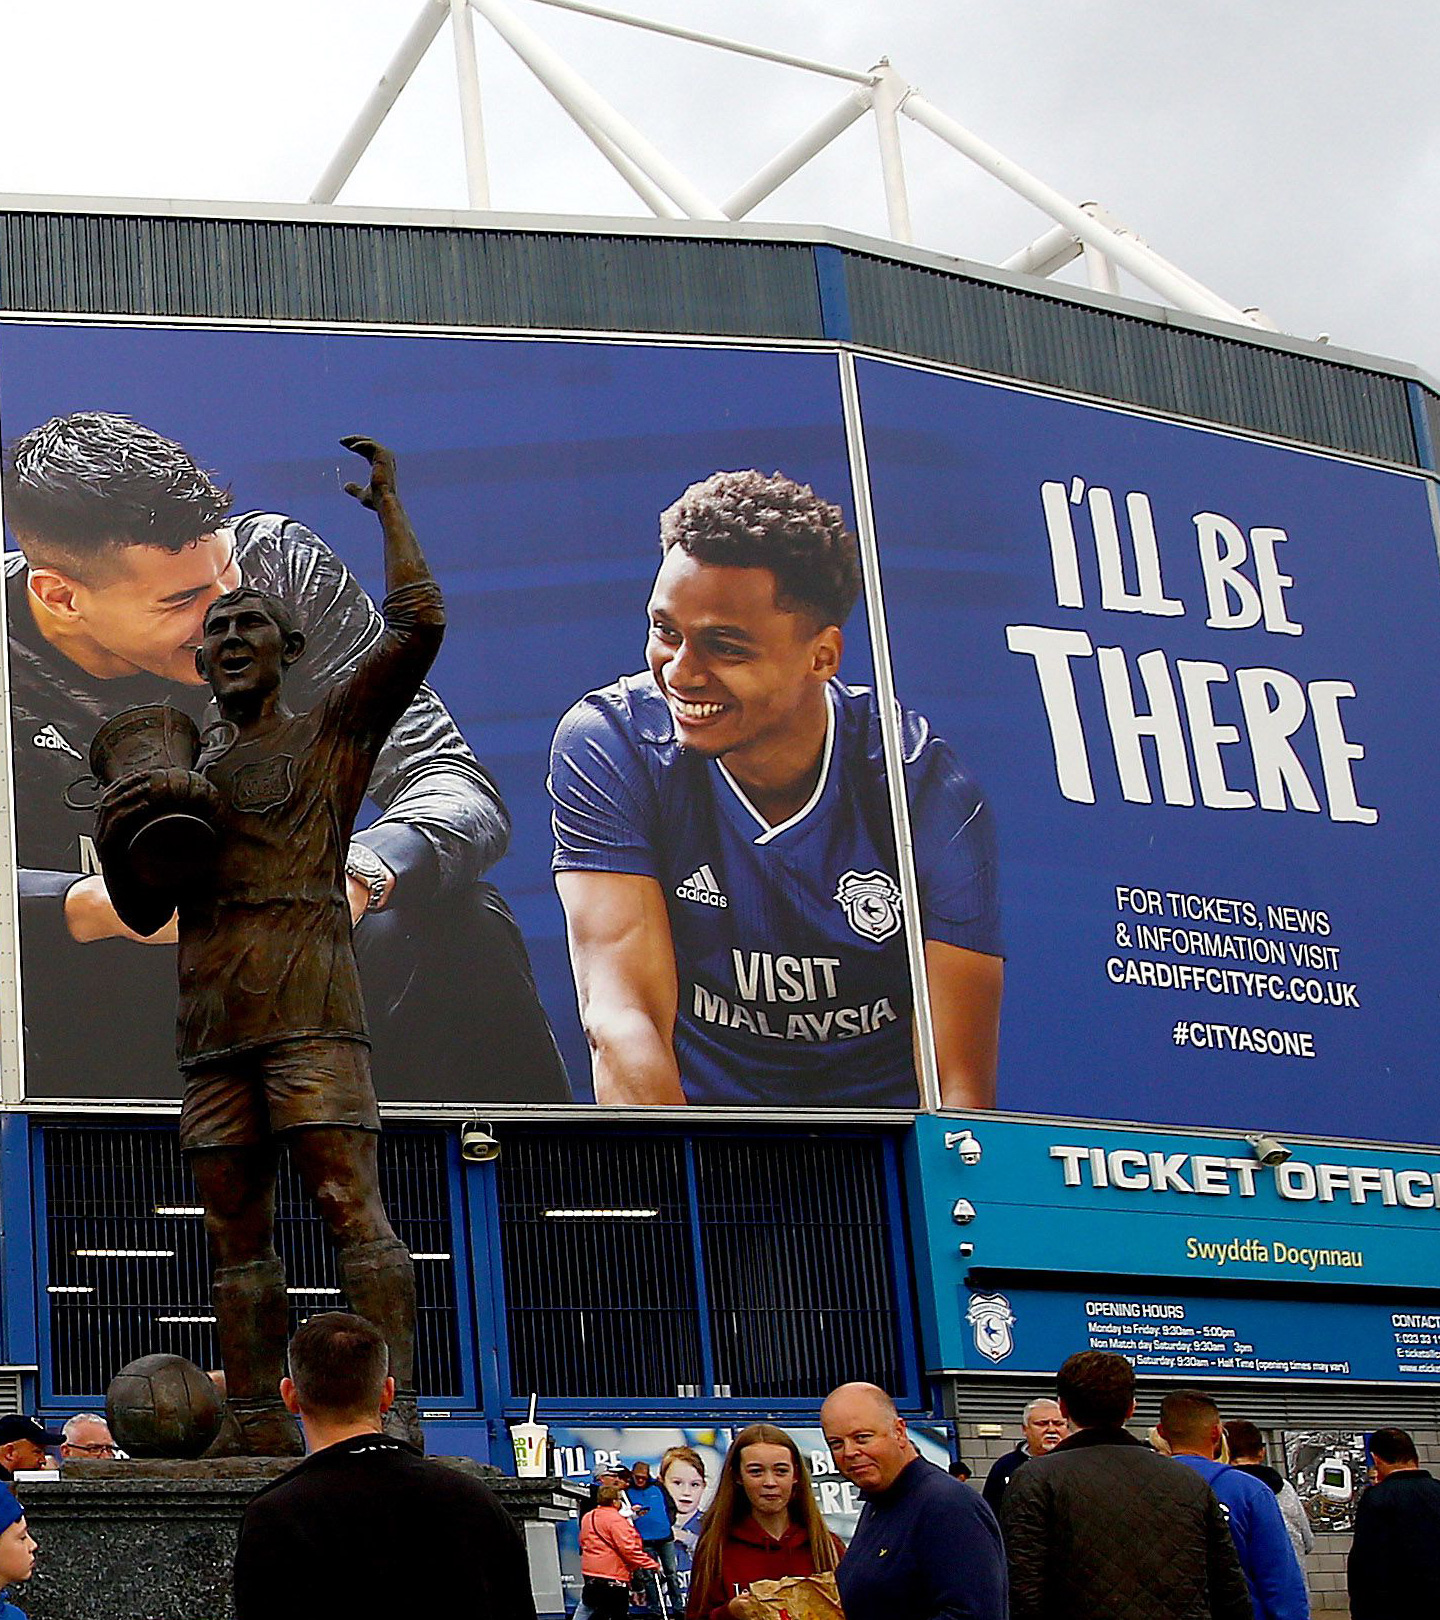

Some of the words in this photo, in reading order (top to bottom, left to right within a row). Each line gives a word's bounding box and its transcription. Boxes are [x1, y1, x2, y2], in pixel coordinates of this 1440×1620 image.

[1040, 477, 1185, 617] I'LL
[1192, 511, 1303, 636] BE
[1005, 625, 1378, 825] THERE
[675, 885, 728, 909] adidas
[1115, 886, 1163, 916] FOR
[1166, 892, 1264, 932] TICKETS,
[1267, 905, 1331, 937] NEWS
[1115, 922, 1132, 949] &
[1136, 924, 1286, 967] INFORMATION
[1292, 943, 1341, 972] VISIT
[731, 948, 841, 1002] VISIT
[1106, 958, 1360, 1008] CARDIFFCITYFC.CO.UK
[692, 983, 898, 1042] MALAYSIA
[1172, 1021, 1317, 1058] #CITYASONE
[1050, 1145, 1263, 1198] TICKET
[1186, 1236, 1269, 1266] Swyddfa
[1273, 1242, 1364, 1271] Docynnau
[1085, 1301, 1141, 1317] OPENING
[1142, 1304, 1185, 1319] HOURS
[1087, 1321, 1122, 1336] Monday
[1123, 1324, 1133, 1334] to
[1162, 1325, 1195, 1336] 9:30am
[1203, 1326, 1236, 1339] 5:00pm
[1090, 1337, 1108, 1349] Non
[1109, 1338, 1137, 1350] Match
[1138, 1340, 1153, 1352] day
[1193, 1341, 1226, 1352] 9:30am
[1233, 1342, 1253, 1354] 3pm
[1217, 1357, 1235, 1369] Half
[1235, 1358, 1255, 1369] Time
[1256, 1359, 1289, 1373] (opening
[1289, 1360, 1312, 1371] times
[1312, 1362, 1330, 1374] may
[553, 1446, 591, 1478] I'LL
